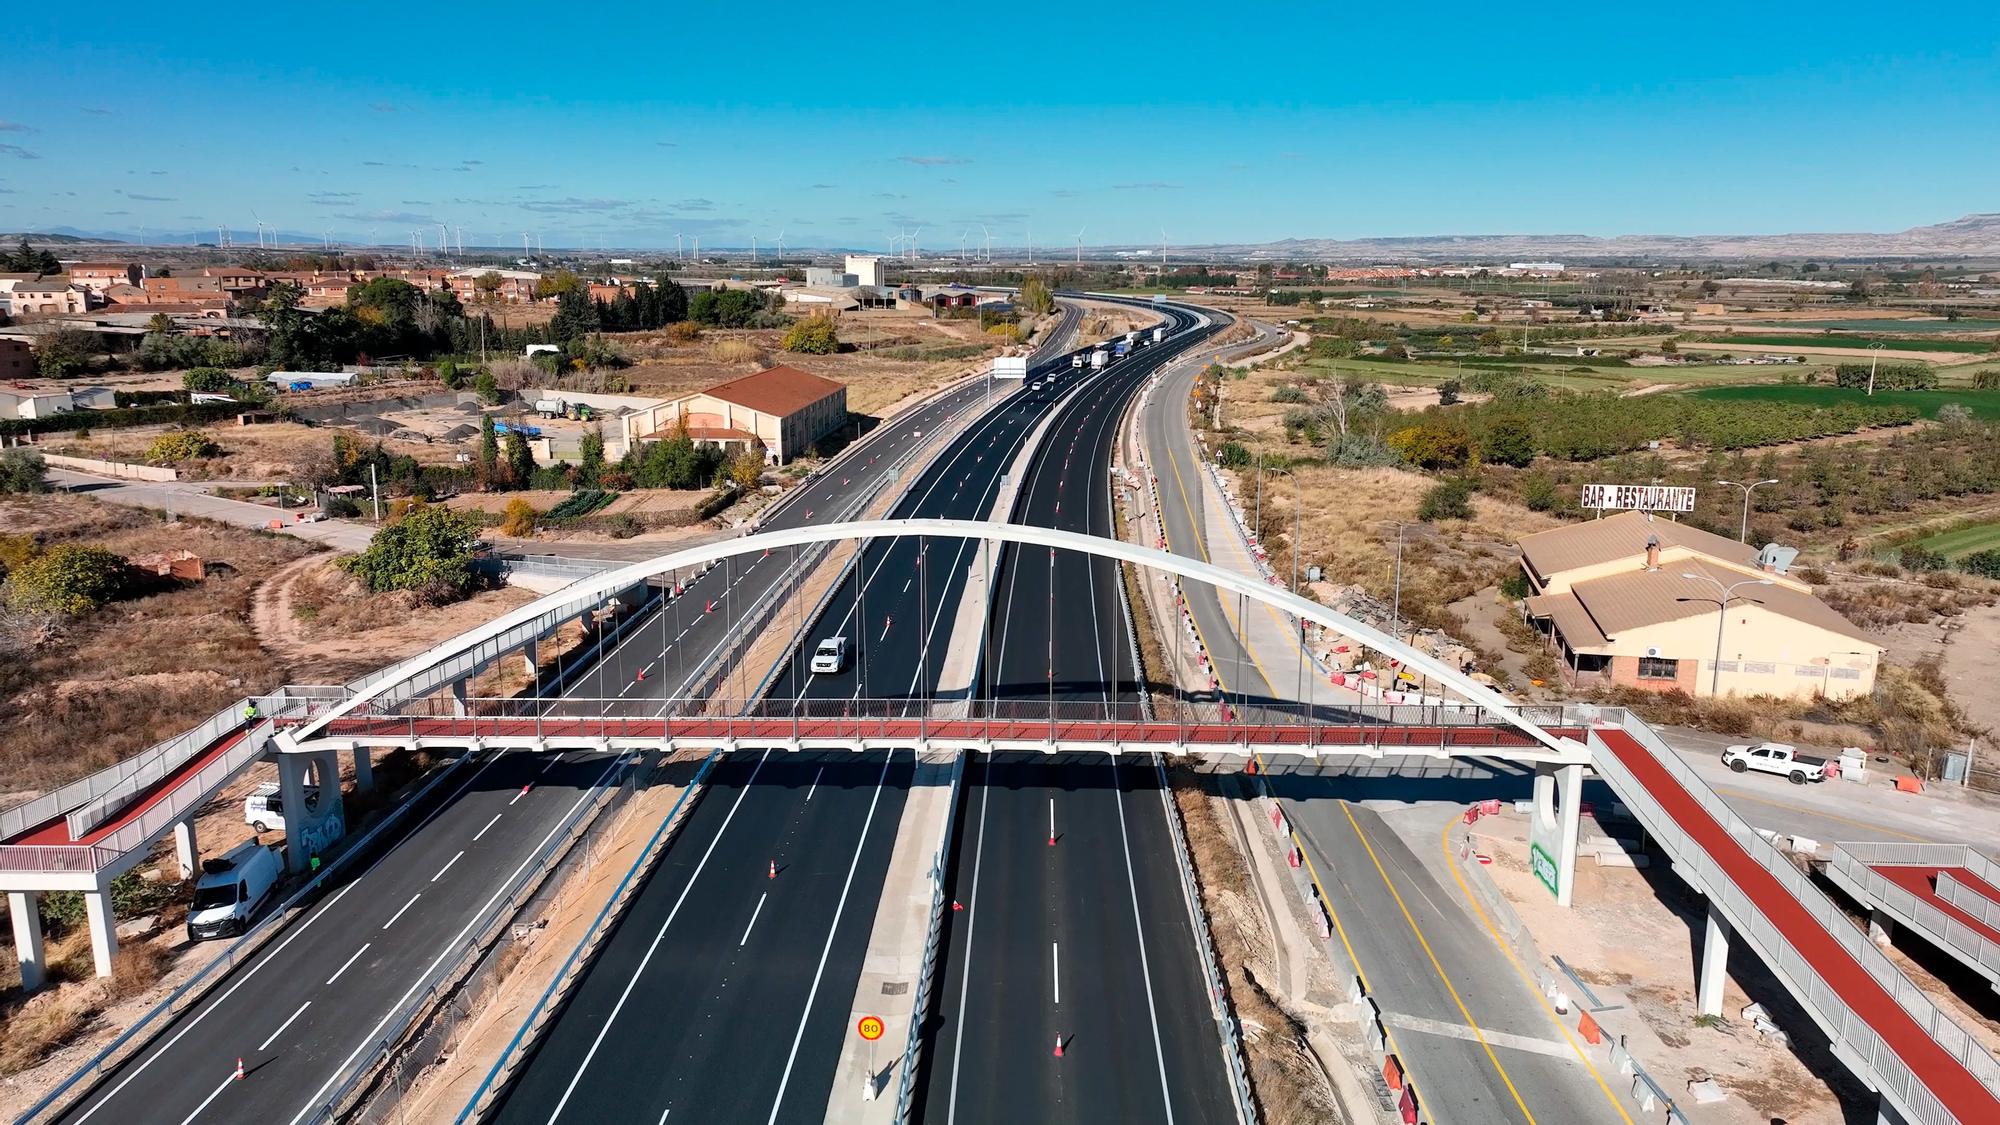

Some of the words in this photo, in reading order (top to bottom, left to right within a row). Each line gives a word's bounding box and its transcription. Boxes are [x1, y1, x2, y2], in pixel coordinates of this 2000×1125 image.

[1583, 486, 1604, 507] BAR
[1616, 487, 1693, 510] RESTAURANTE
[863, 1024, 878, 1032] 80
